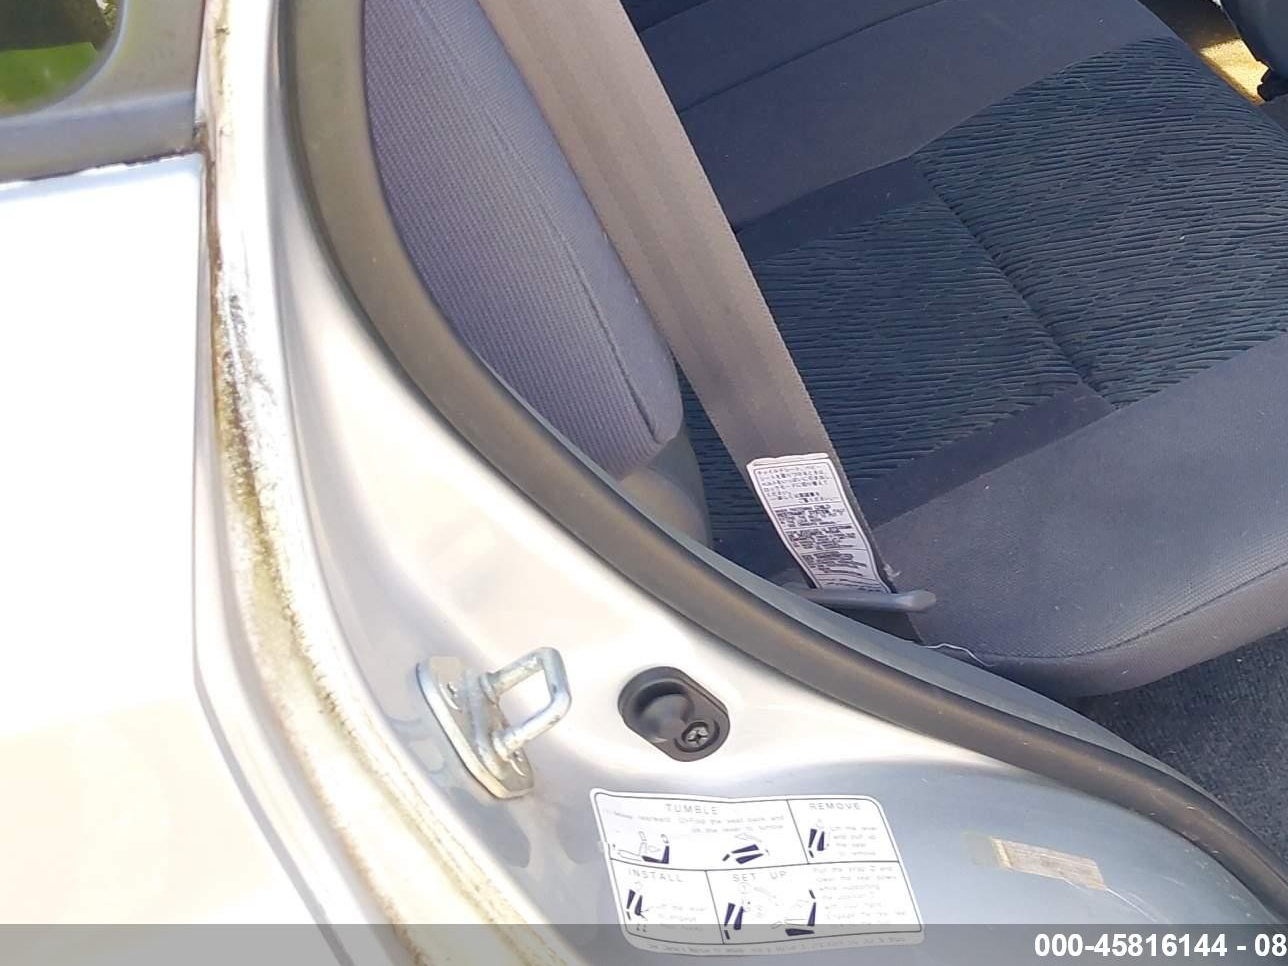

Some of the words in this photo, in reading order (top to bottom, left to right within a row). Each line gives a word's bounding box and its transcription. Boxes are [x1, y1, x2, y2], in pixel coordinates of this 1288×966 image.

[808, 801, 862, 811] REMOVE
[628, 868, 684, 883] INSTALL
[732, 872, 757, 883] SET
[769, 870, 788, 881] UP
